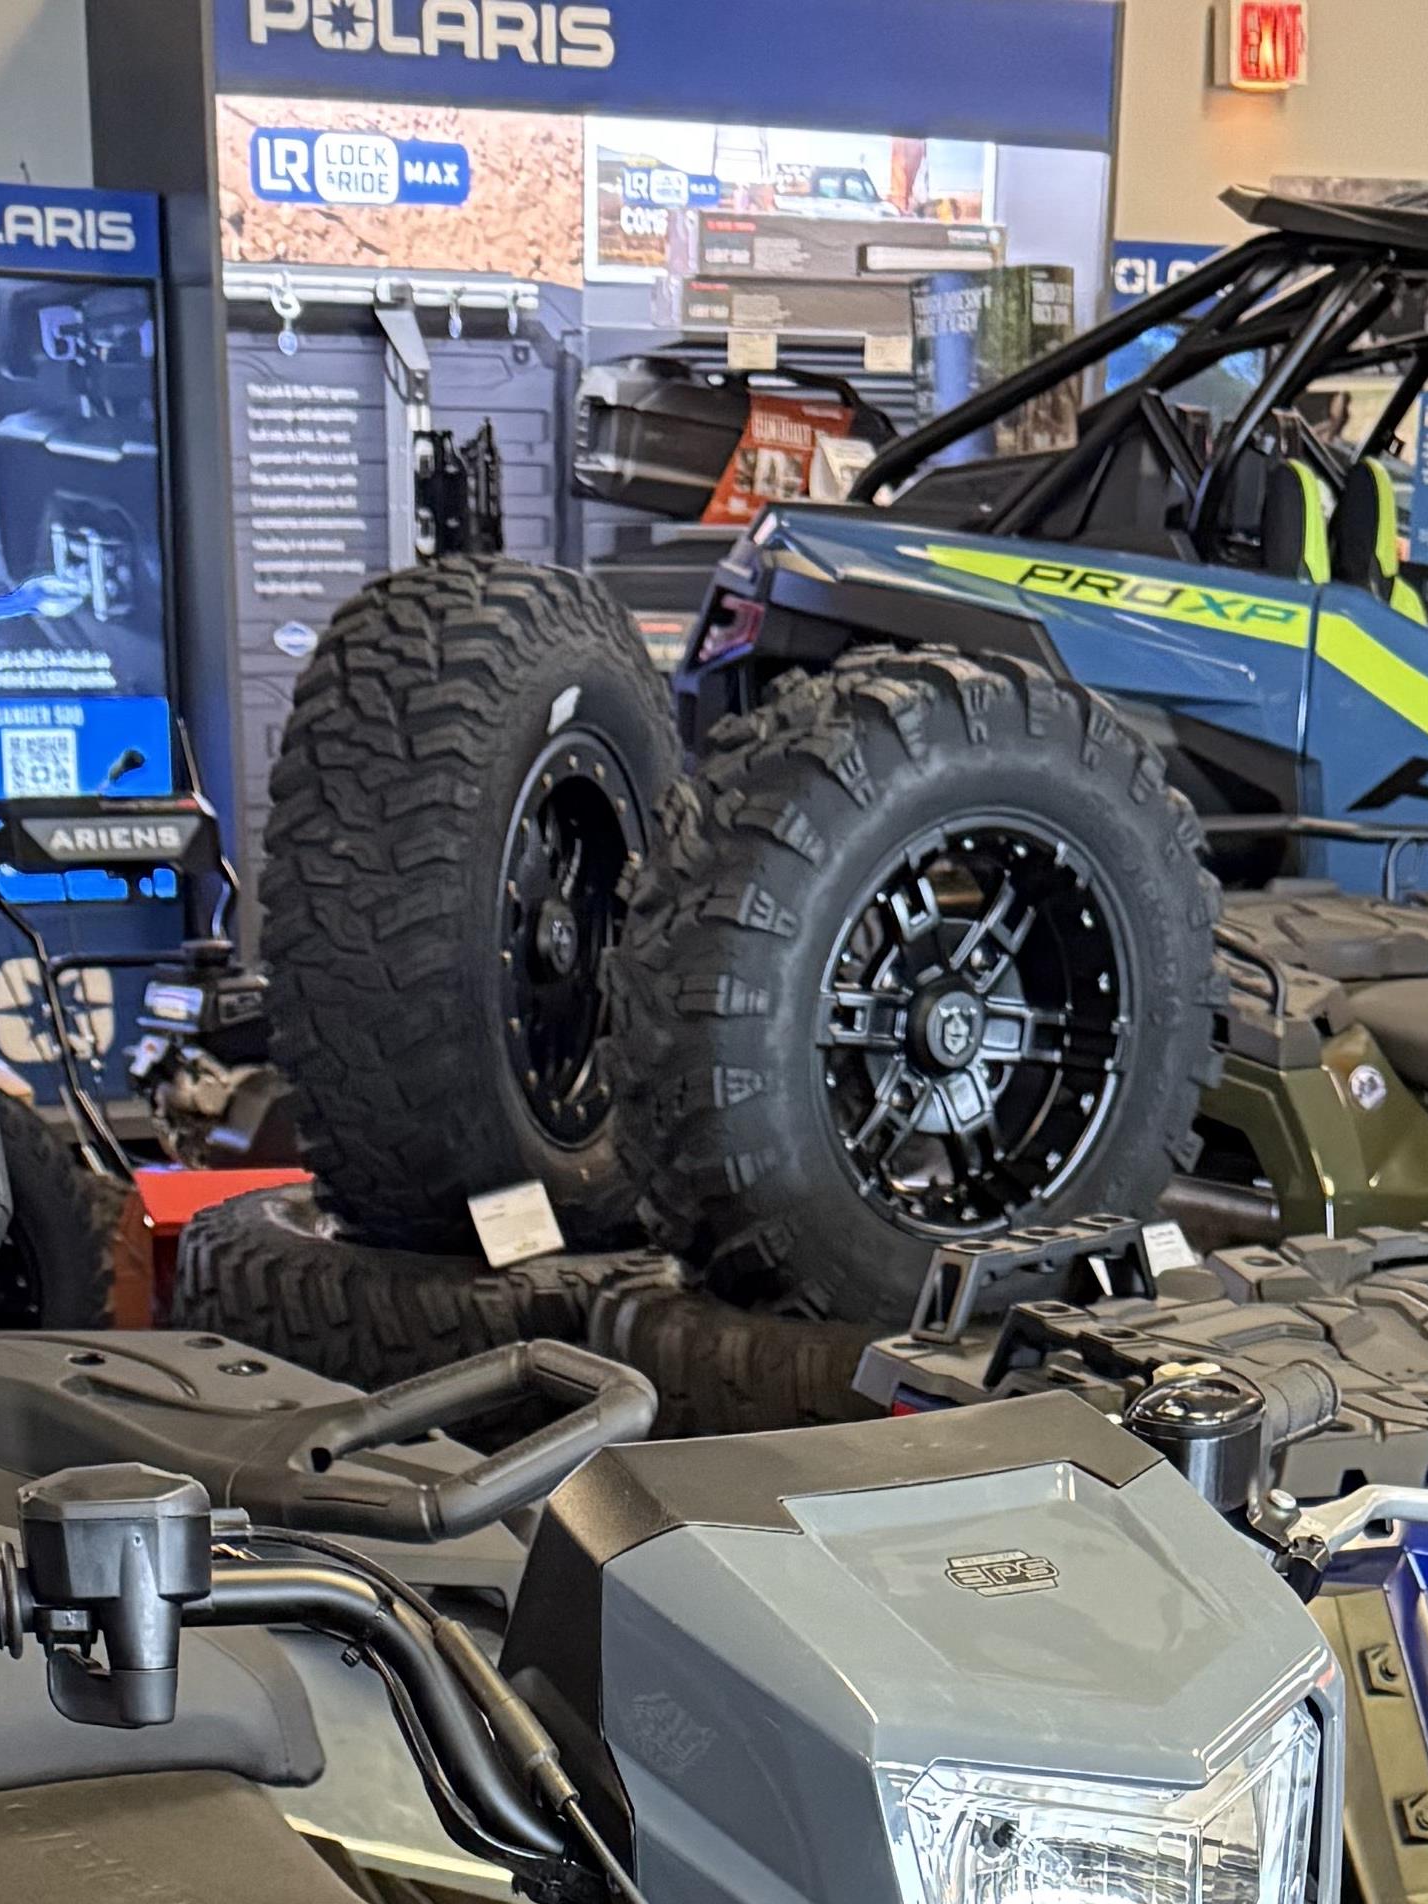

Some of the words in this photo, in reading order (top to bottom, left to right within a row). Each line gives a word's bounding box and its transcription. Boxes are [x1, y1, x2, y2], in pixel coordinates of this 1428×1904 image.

[248, 0, 615, 68] POLARIS
[325, 144, 387, 166] LOCK
[404, 160, 459, 187] MAX
[1018, 564, 1185, 608] PRO
[1181, 592, 1298, 622] XP
[50, 826, 180, 851] ARIENS
[945, 1557, 1059, 1588] EPS
